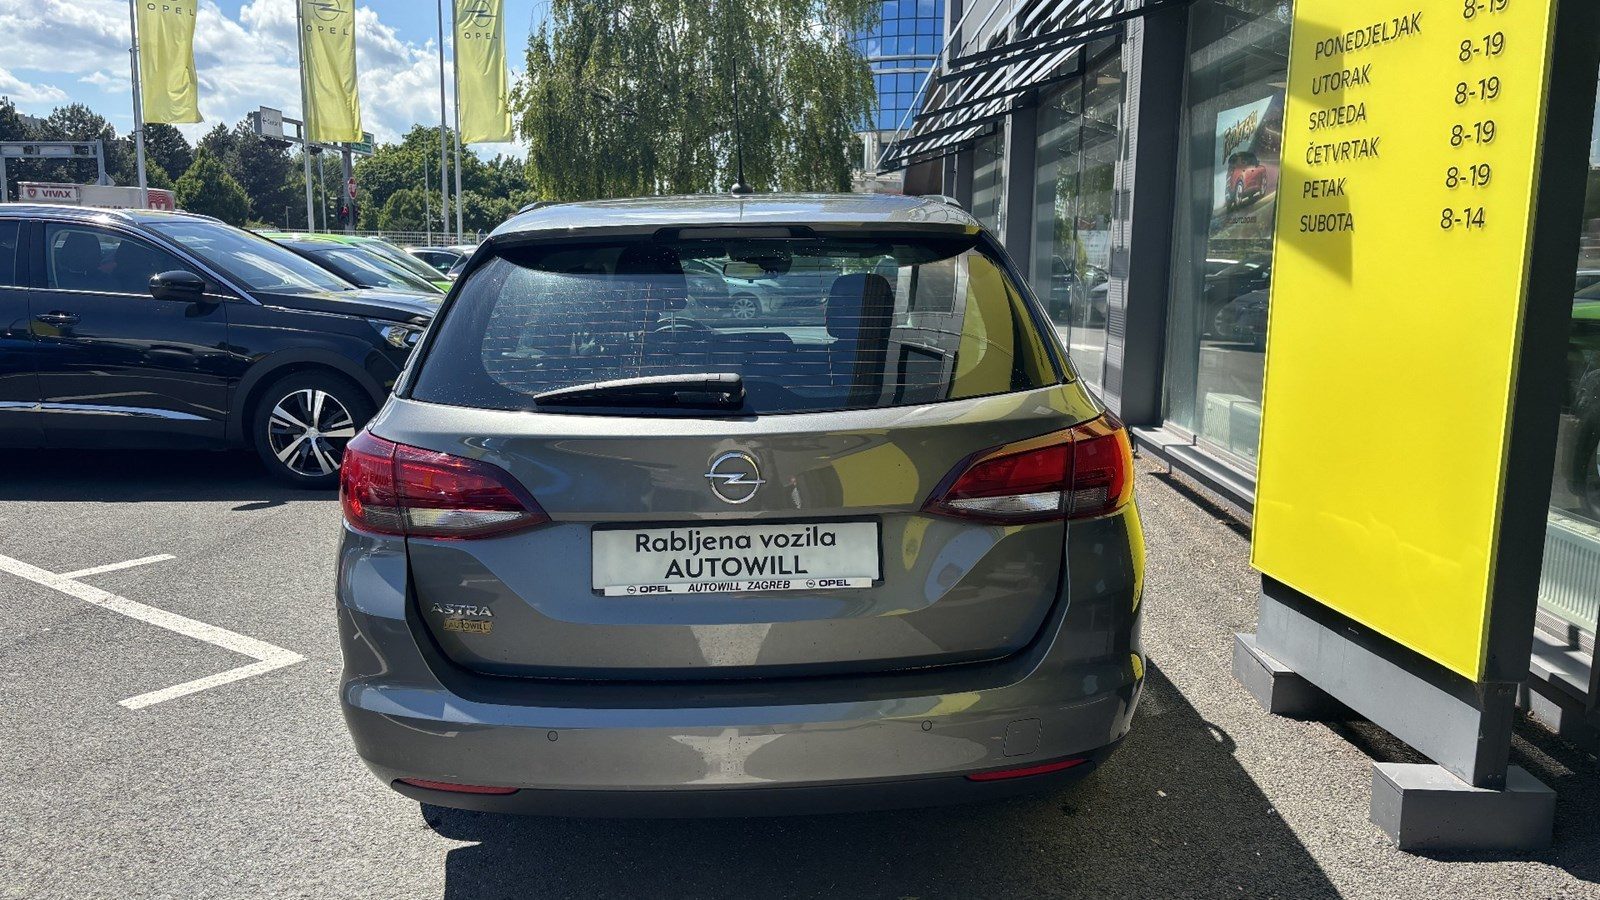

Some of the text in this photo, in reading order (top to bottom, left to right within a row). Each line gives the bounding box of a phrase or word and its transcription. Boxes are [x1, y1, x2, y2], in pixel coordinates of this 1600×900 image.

[147, 3, 194, 17] OPEL
[306, 24, 349, 36] OPEL
[464, 32, 498, 40] OPEL
[1314, 12, 1423, 60] PONEDJELJAK
[1311, 31, 1505, 95] UTORAK 8-19
[1308, 76, 1500, 131] SRIJEDA 8-19
[1305, 119, 1495, 165] ČETVRTAK 8-19
[1302, 163, 1491, 199] PETAK 8-19
[42, 189, 72, 199] VIVAX
[1299, 207, 1486, 233] SUBOTA 8-14
[635, 526, 837, 556] Rabljena vozila
[665, 554, 809, 579] AUTOWILL
[639, 579, 851, 593] OPEL AUTOWILL ZAGREB OPEL
[431, 602, 493, 617] ASTRA
